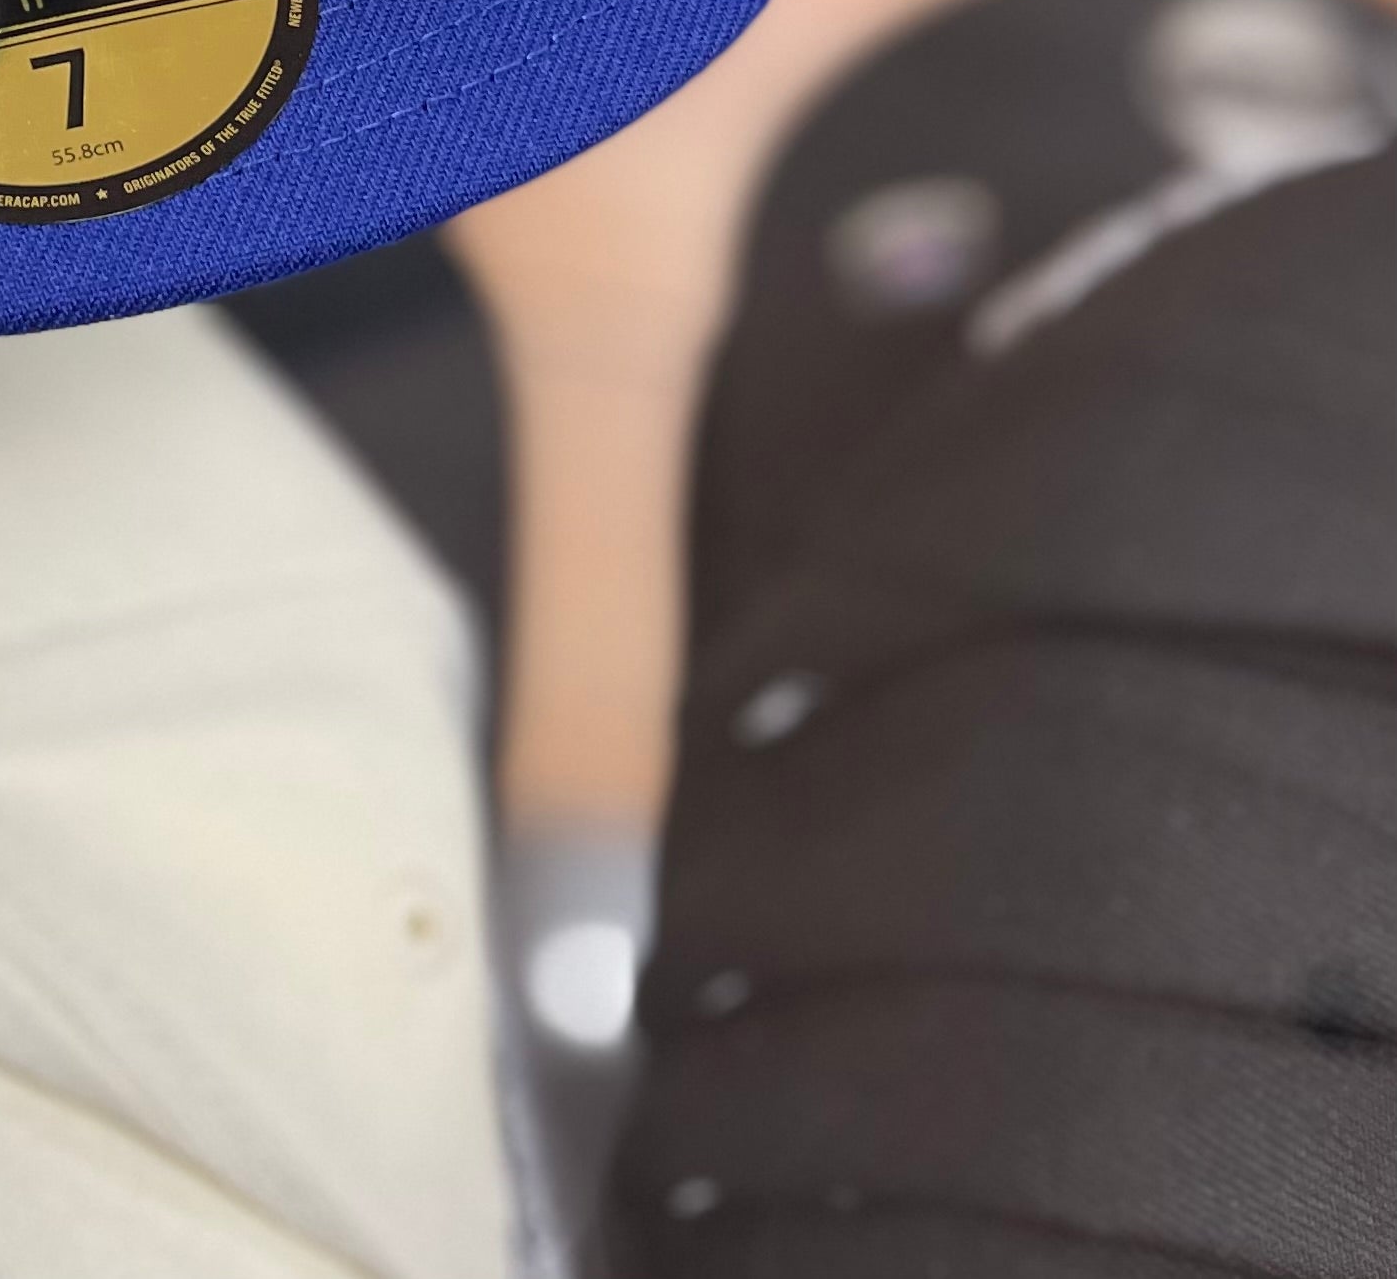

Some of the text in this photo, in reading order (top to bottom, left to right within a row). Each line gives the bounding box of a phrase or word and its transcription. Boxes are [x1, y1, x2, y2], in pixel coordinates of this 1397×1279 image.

[29, 47, 85, 130] 7
[52, 140, 124, 166] 55.8cm
[122, 151, 202, 195] ORIGINATORS
[199, 139, 217, 156] OF
[214, 122, 240, 144] THE
[234, 98, 263, 125] TRUE
